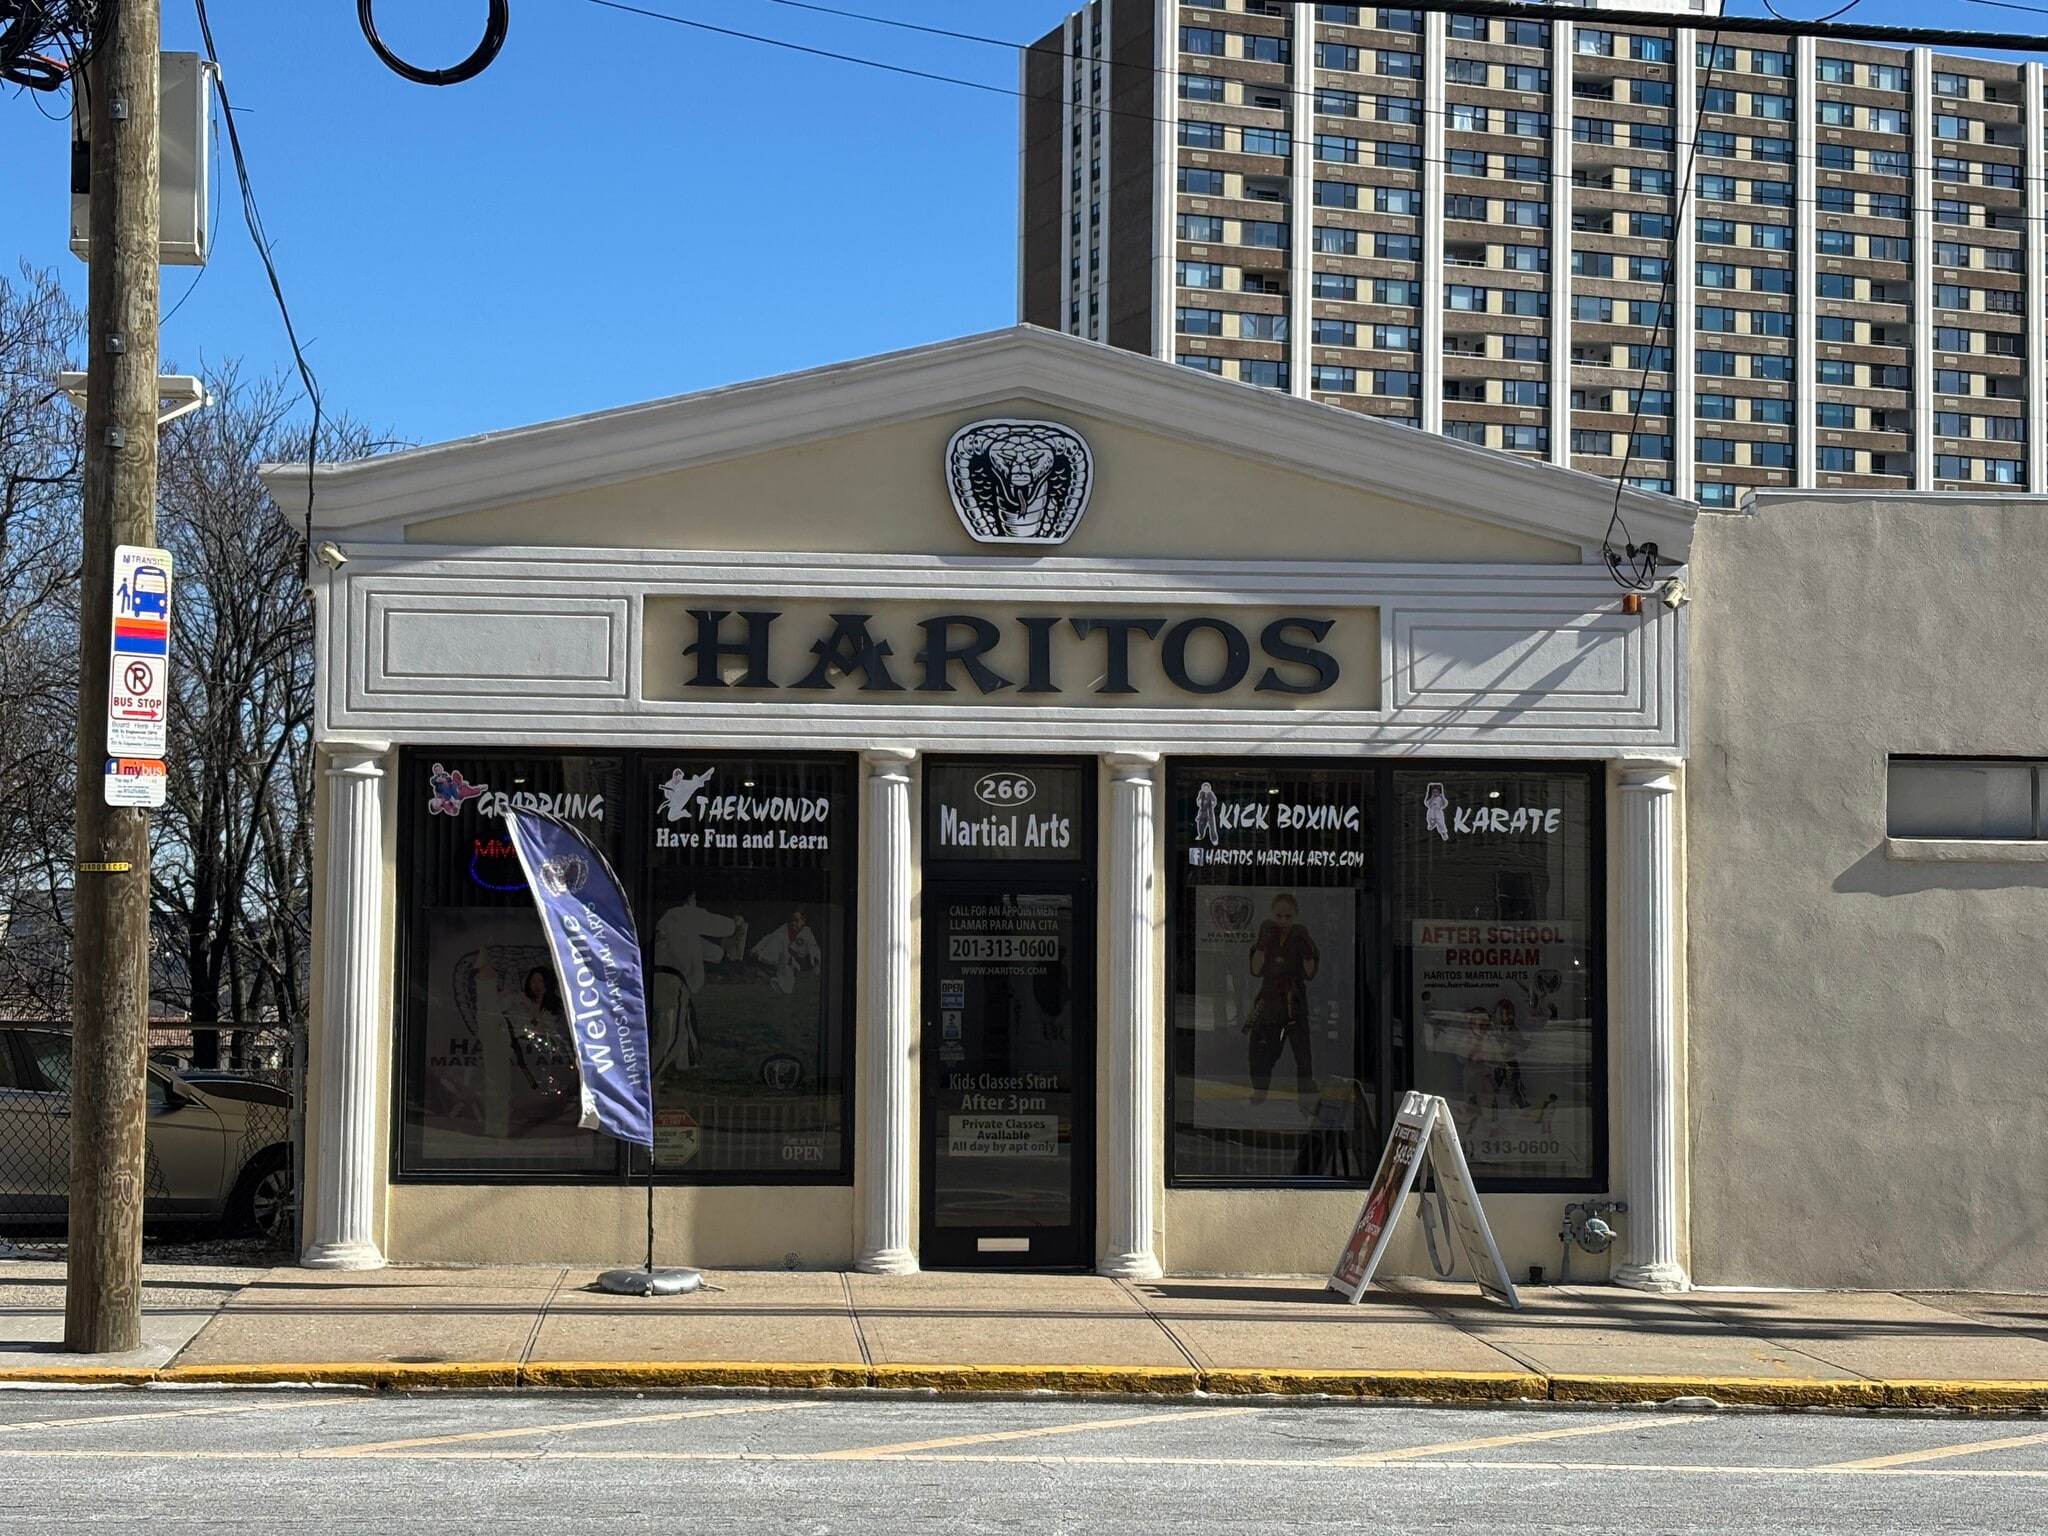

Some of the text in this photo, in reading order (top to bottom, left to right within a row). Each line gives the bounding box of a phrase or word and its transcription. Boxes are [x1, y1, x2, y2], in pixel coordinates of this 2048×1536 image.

[131, 555, 165, 566] TRANSIT
[682, 608, 1341, 696] HARITOS
[113, 697, 162, 709] BUS STOP
[981, 779, 1029, 800] 266
[696, 794, 830, 823] TAEKWONDO
[1219, 802, 1361, 833] KICK BOXING
[941, 803, 1071, 849] Martial Arts
[1454, 806, 1562, 835] KARATE
[655, 828, 829, 850] Have Fun and Learn
[1205, 848, 1254, 867] HARITOS
[949, 905, 1059, 917] CALL FOR AN APPOINTMENT
[949, 919, 1059, 931] LLAMAR PARA UNA CITA
[1421, 926, 1565, 945] AFTER SCHOOL
[952, 939, 1056, 958] 201-313-0600
[1445, 948, 1541, 966] PROGRAM
[961, 966, 1048, 976] WWW.HARITOS.COM
[1424, 970, 1529, 981] HARITOS MARTIAL ARTS
[599, 948, 626, 1013] MARTIAL
[942, 983, 964, 993] OPEN
[563, 914, 615, 1075] Welcome
[614, 1015, 641, 1086] HARITOS
[949, 1073, 1059, 1090] Kids Classes Start
[961, 1093, 1046, 1114] After 3pm
[962, 1119, 1046, 1129] Private Classes
[977, 1131, 1030, 1141] Available
[782, 1145, 824, 1161] OPEN
[952, 1141, 1056, 1154] All day by apt only
[1482, 1140, 1560, 1155] 313-0600
